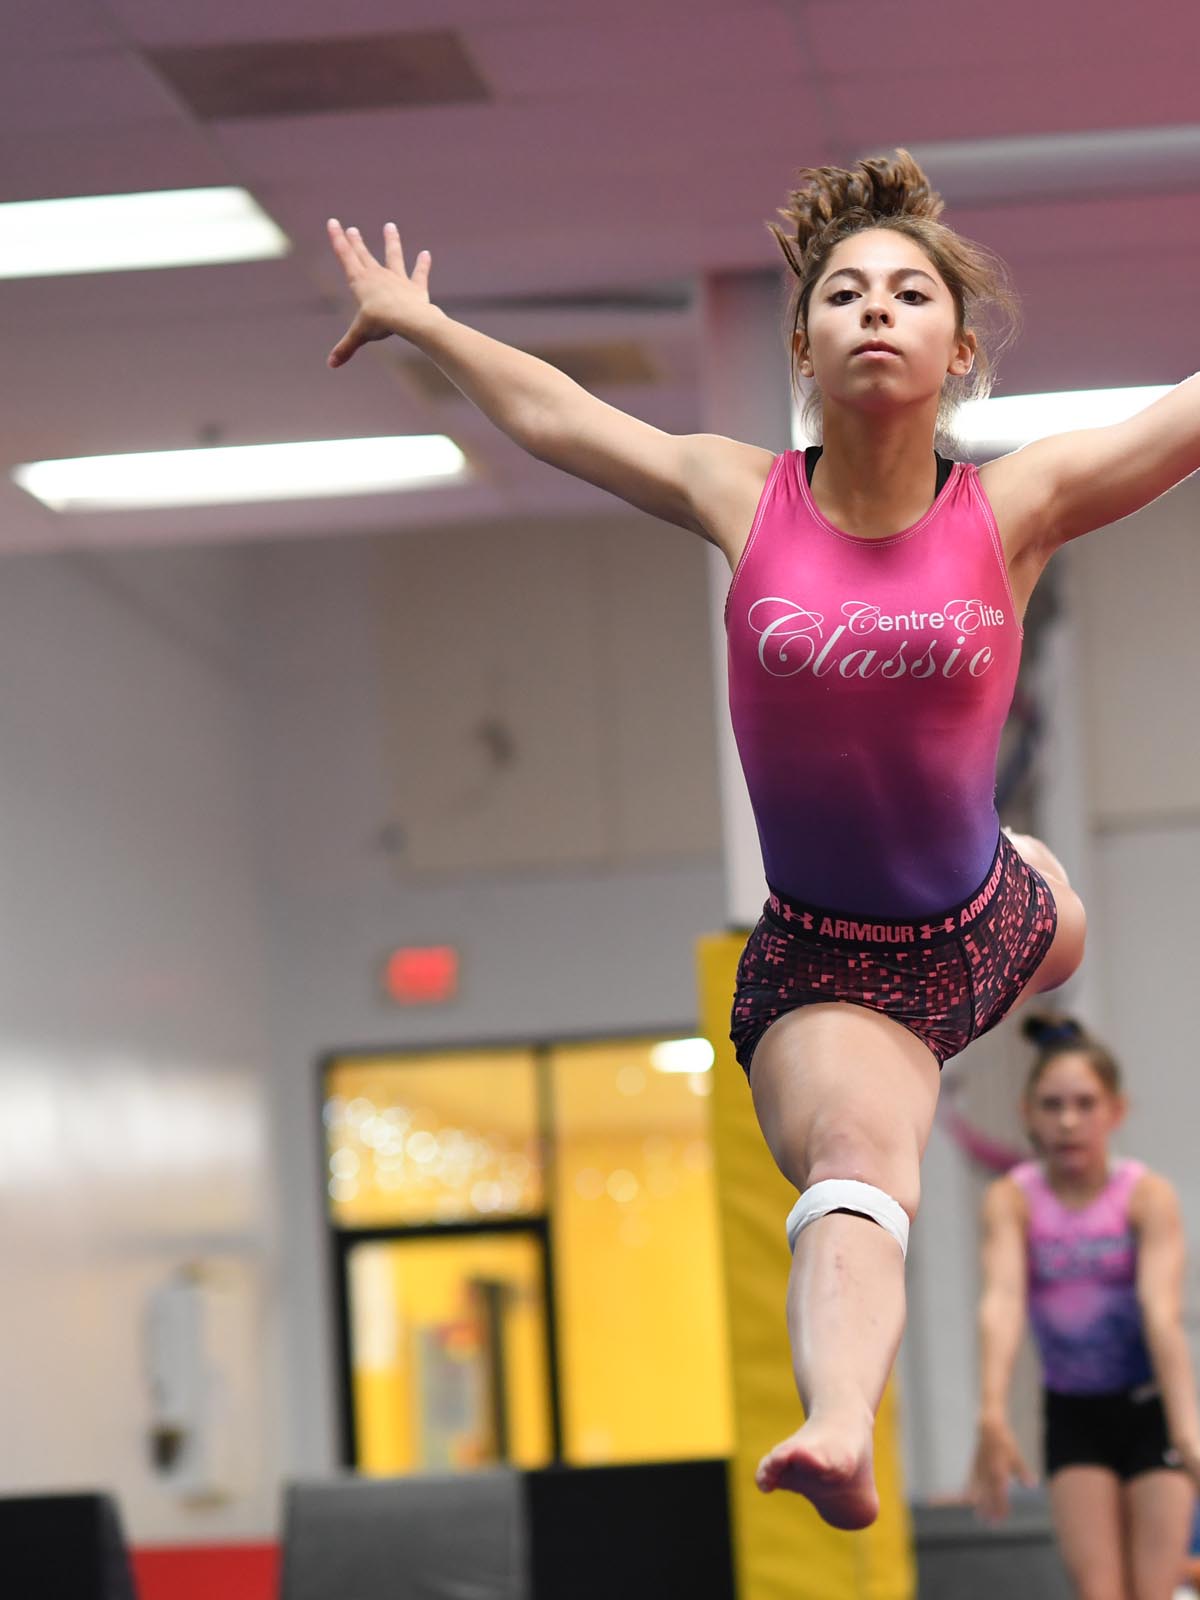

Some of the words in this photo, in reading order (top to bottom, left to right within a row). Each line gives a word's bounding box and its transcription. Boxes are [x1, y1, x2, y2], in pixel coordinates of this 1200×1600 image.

[748, 597, 995, 679] Classic
[841, 600, 944, 636] Centre
[944, 599, 1005, 636] Elite
[819, 917, 915, 943] ARMOUR
[960, 856, 1003, 927] ARMOUR
